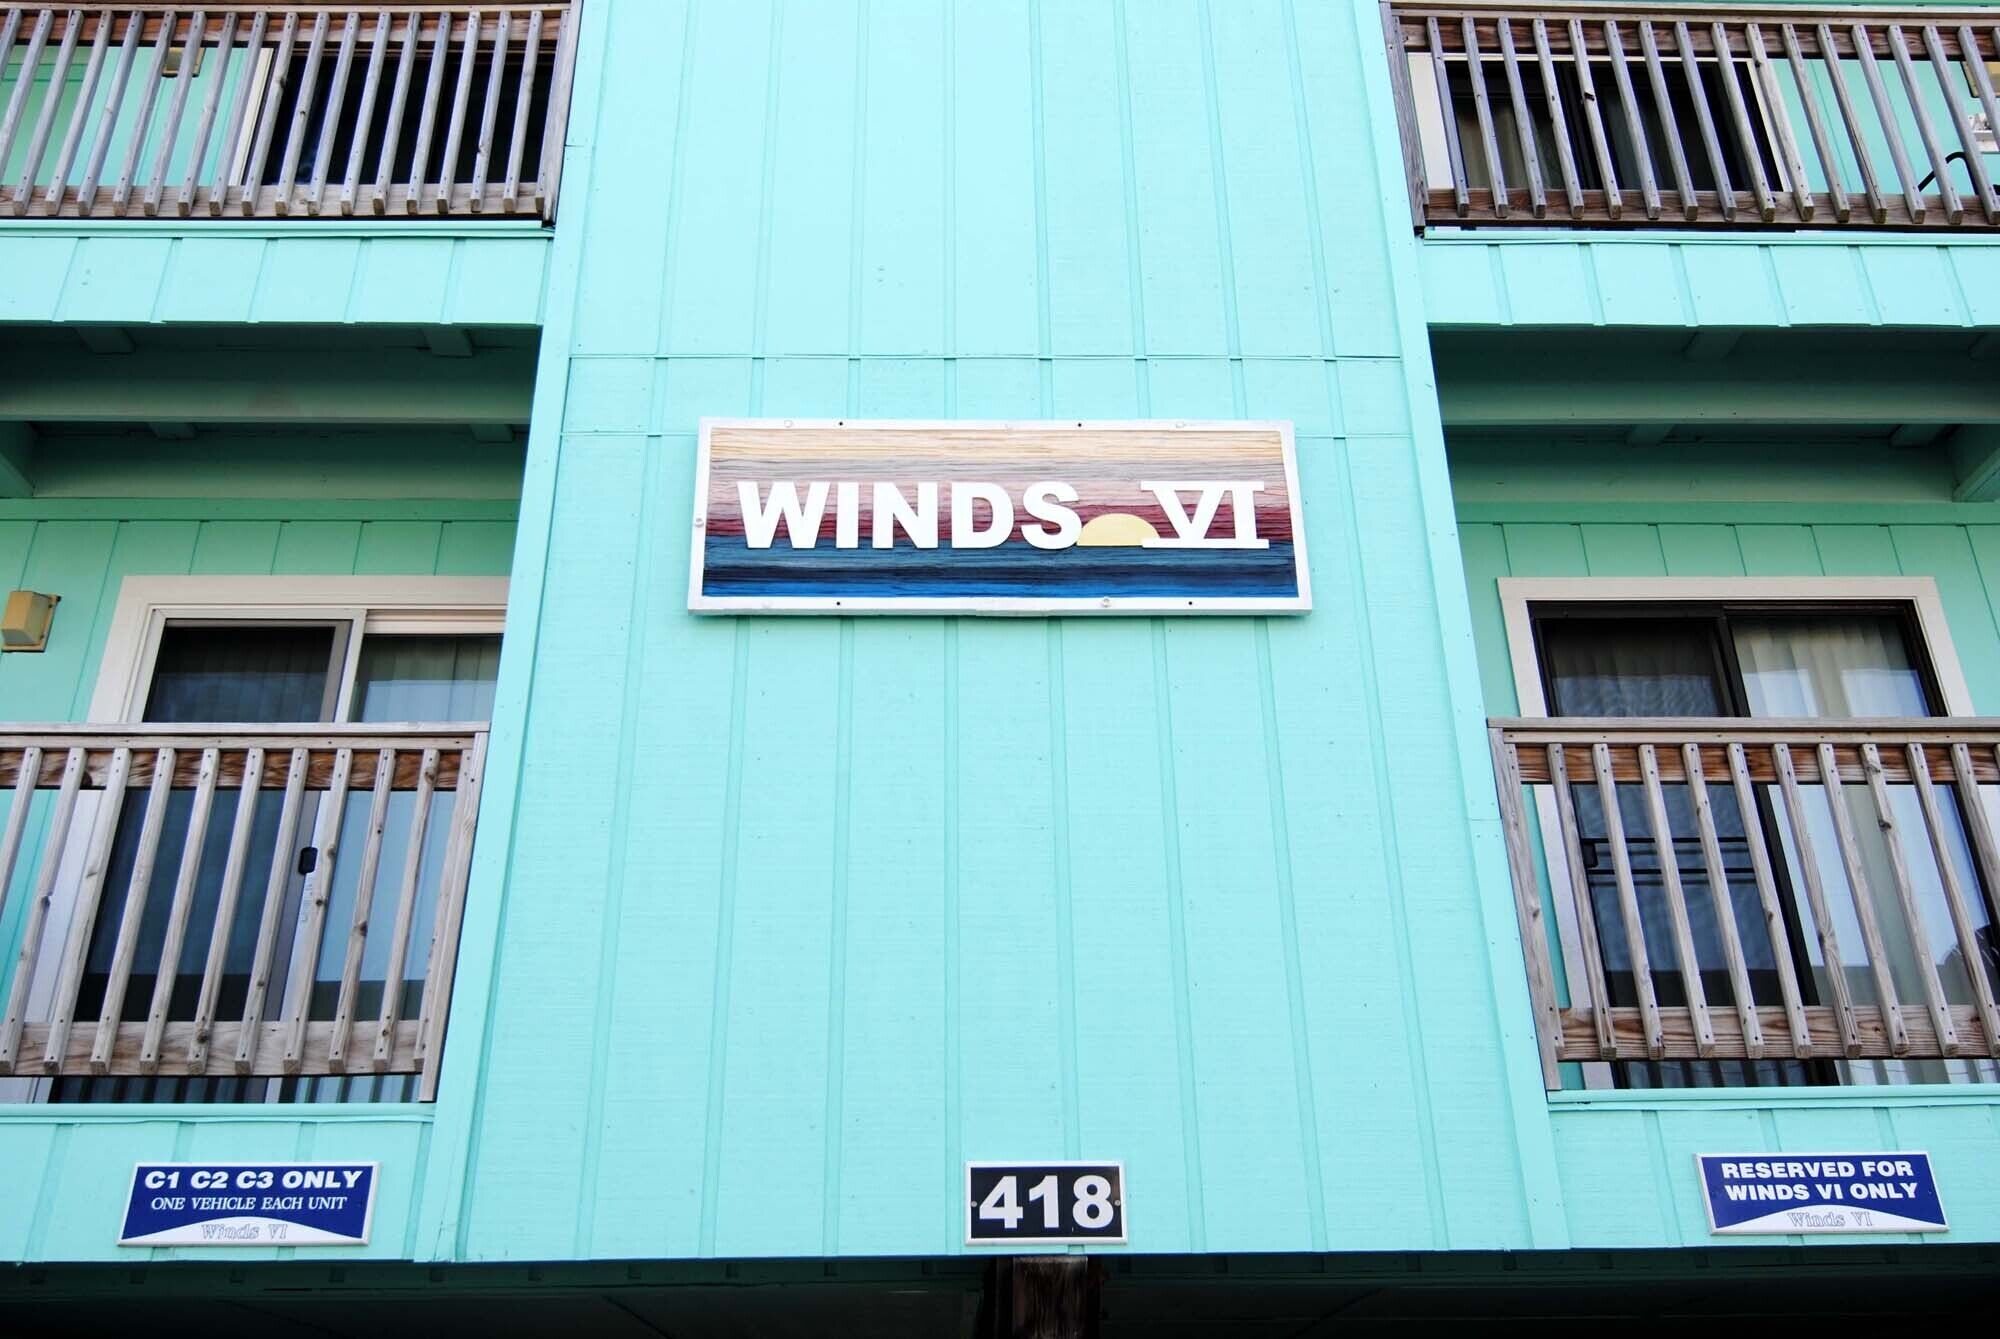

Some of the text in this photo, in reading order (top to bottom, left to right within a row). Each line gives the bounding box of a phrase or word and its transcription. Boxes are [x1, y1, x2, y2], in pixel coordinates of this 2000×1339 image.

[736, 480, 1270, 550] WINDS VI
[1721, 1161, 1914, 1179] RESERVED FOR
[144, 1170, 363, 1190] C1 C2 C3 ONLY
[1724, 1182, 1918, 1201] WINDS VI ONLY
[151, 1196, 348, 1210] ONE VEHICLE EACH UNIT
[979, 1174, 1115, 1229] 418
[1786, 1211, 1873, 1228] Winds VI
[200, 1223, 289, 1240] Winds VI
